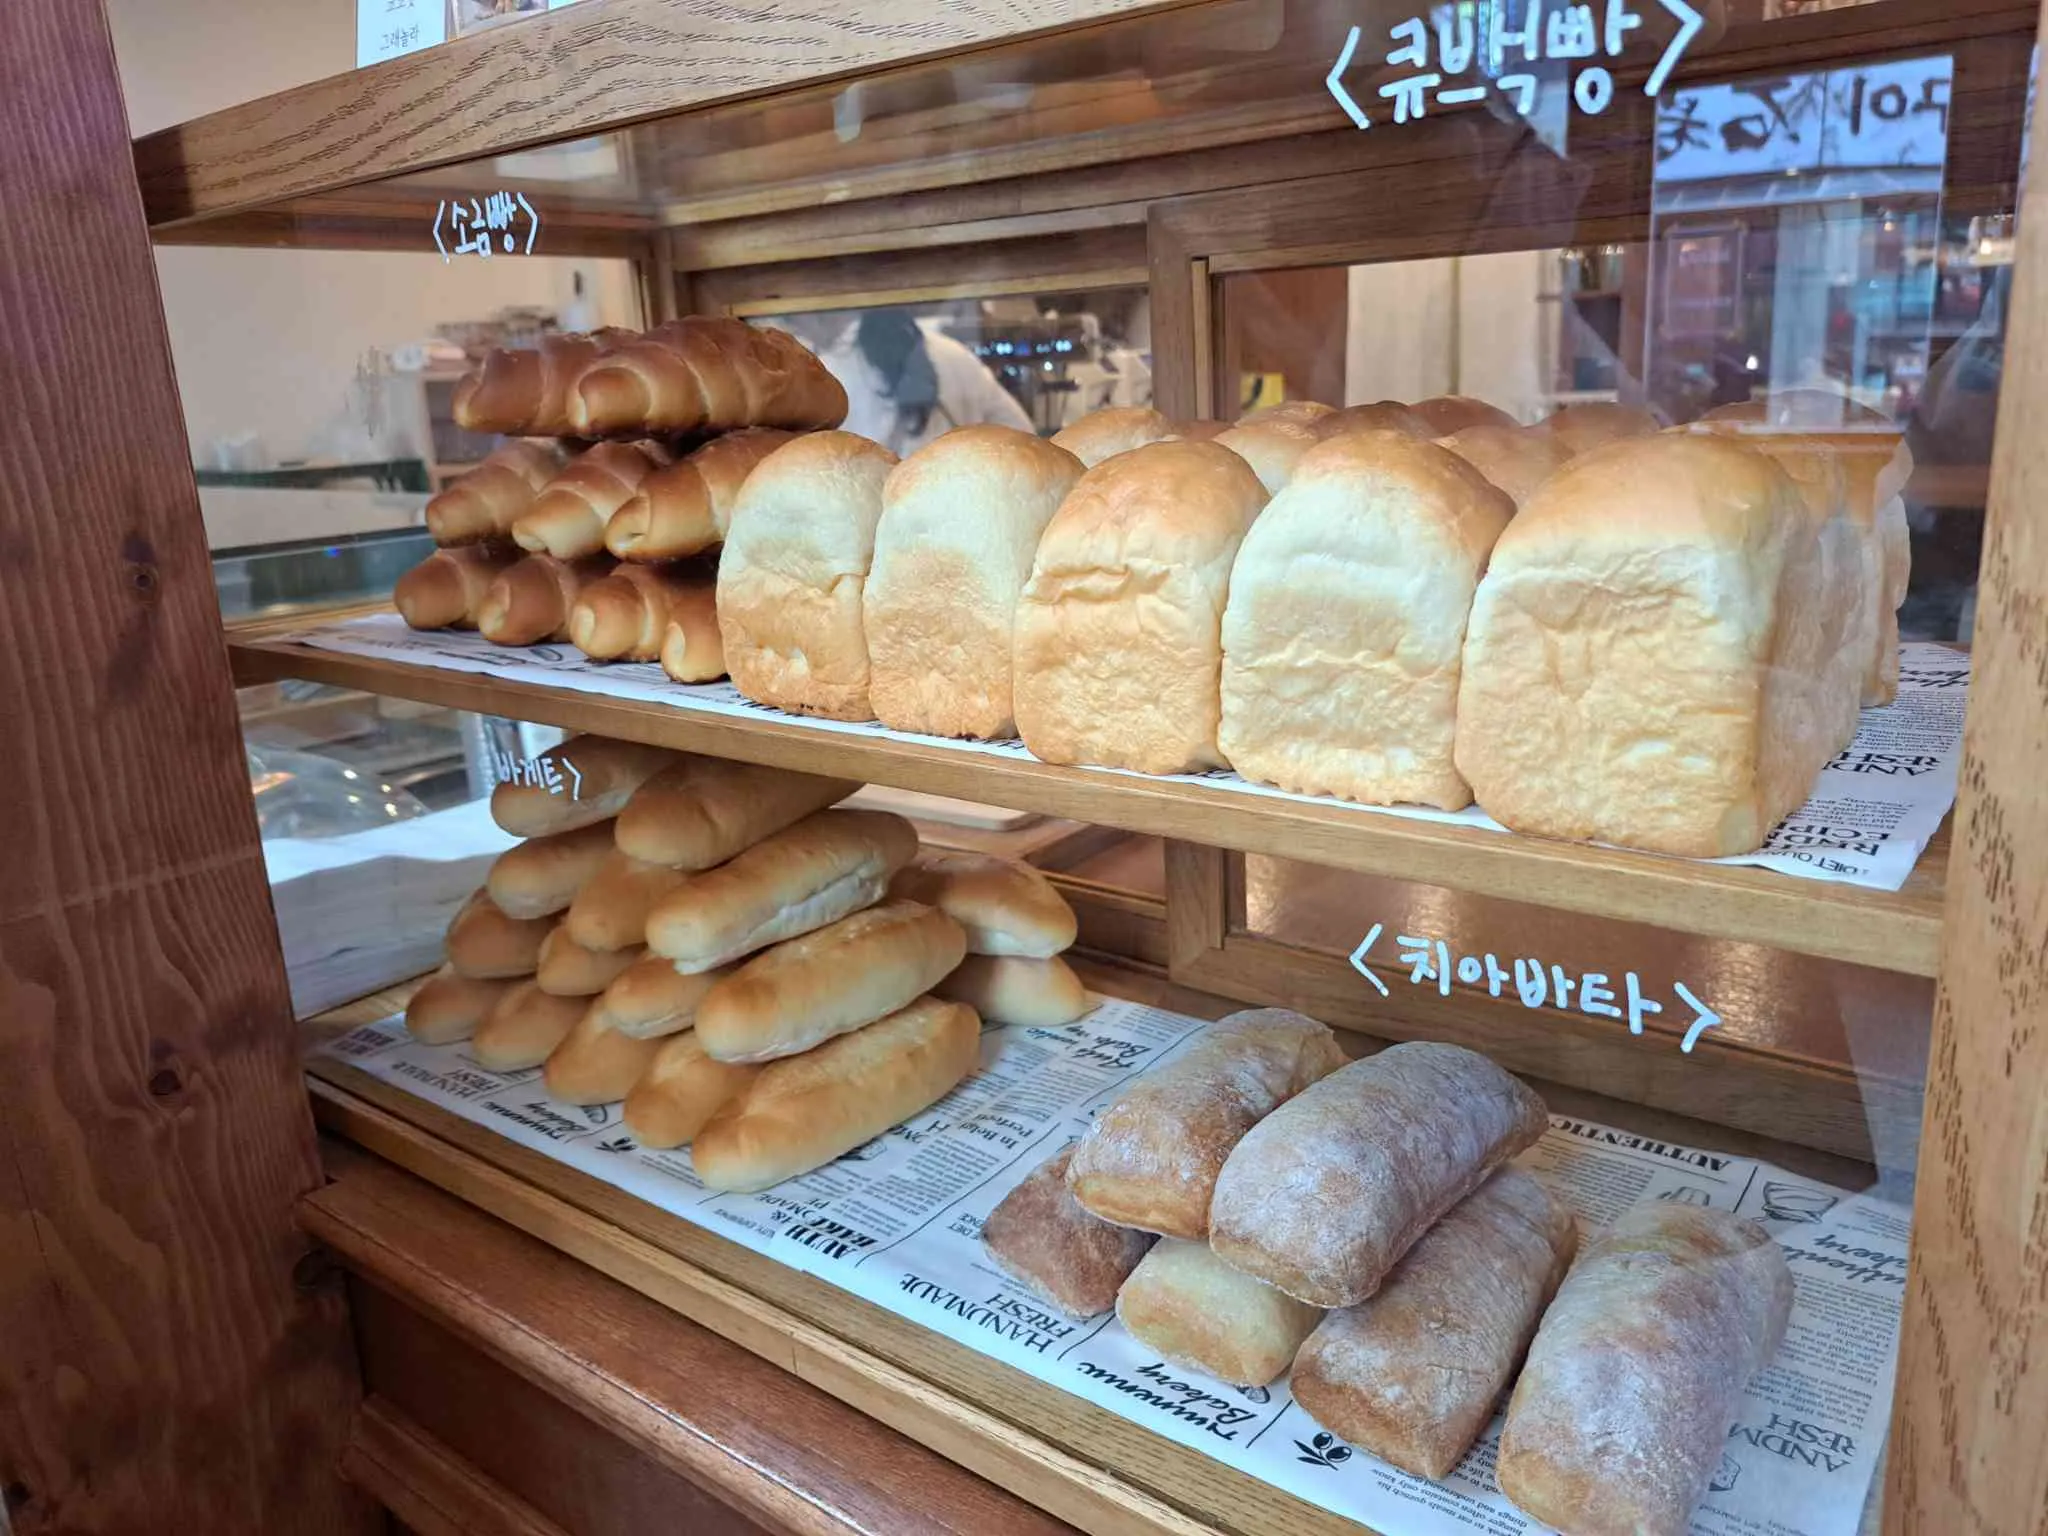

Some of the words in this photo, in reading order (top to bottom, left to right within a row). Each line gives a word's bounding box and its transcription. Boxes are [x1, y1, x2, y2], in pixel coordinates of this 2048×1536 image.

[1550, 1117, 1732, 1172] AUTHENTIC
[984, 1293, 1076, 1340] FRESH
[1135, 1362, 1257, 1426] Bakery
